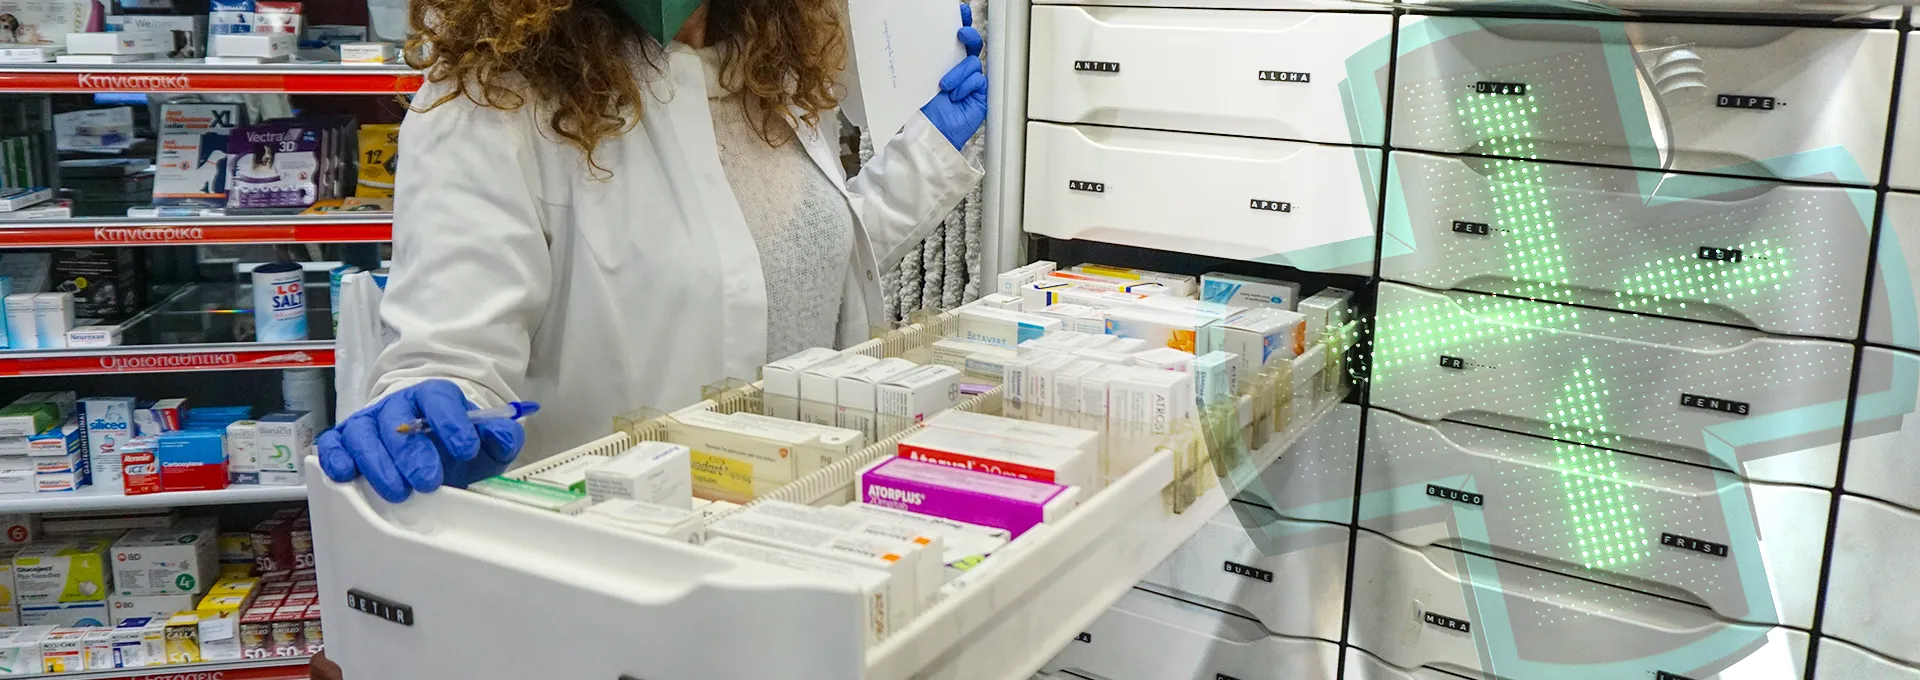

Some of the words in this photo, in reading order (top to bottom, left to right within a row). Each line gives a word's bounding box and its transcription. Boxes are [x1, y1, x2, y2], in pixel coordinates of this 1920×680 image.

[1075, 61, 1118, 72] ANTIV
[78, 71, 190, 90] Κτηνιατρικά
[1259, 72, 1308, 82] ALOHA
[1720, 97, 1770, 109] DIPE
[209, 109, 235, 128] XL
[246, 131, 283, 142] Vectra
[279, 141, 296, 152] 3D
[365, 150, 382, 164] 12
[1070, 181, 1102, 192] ATAC
[1251, 200, 1288, 211] APOF
[1454, 223, 1485, 234] FEL
[277, 283, 299, 294] LO
[272, 292, 303, 308] SALT
[71, 333, 104, 341] Neurexan
[967, 330, 1007, 346] BETAVERT
[1441, 357, 1461, 368] FR
[1682, 395, 1746, 414] FENIS
[79, 413, 90, 474] GASTROINTESTINAL
[124, 454, 151, 462] Rennie
[1428, 488, 1480, 504] GLUCO
[1663, 536, 1724, 556] FRISI
[128, 553, 141, 561] BD
[294, 553, 314, 569] 50
[1226, 563, 1270, 582] BUATE
[348, 593, 405, 624] BETIR
[1426, 614, 1468, 632] MURA
[166, 631, 196, 640] CALLA
